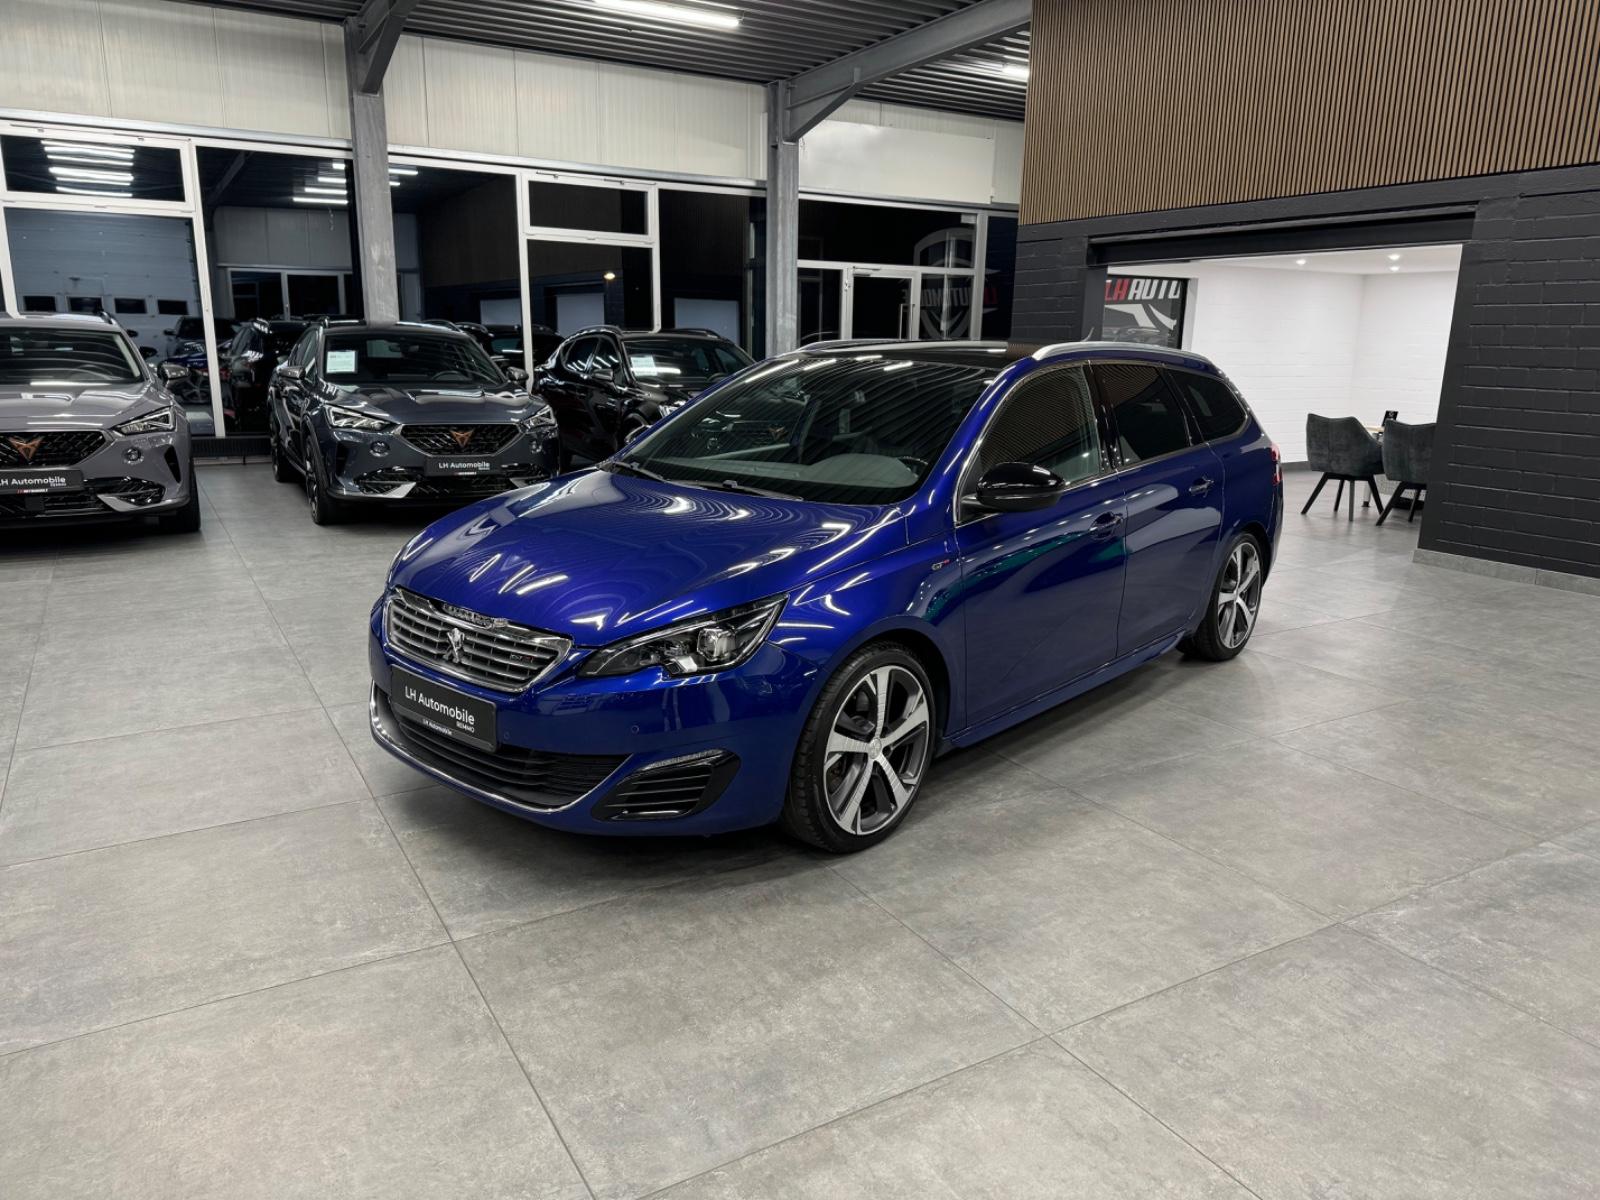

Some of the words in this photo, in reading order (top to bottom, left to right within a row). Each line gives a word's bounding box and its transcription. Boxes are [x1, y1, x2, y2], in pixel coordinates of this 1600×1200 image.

[450, 461, 490, 469] Automobile
[0, 478, 9, 486] H
[11, 476, 66, 485] Automobile
[404, 686, 417, 701] LH
[418, 693, 475, 725] Automobile
